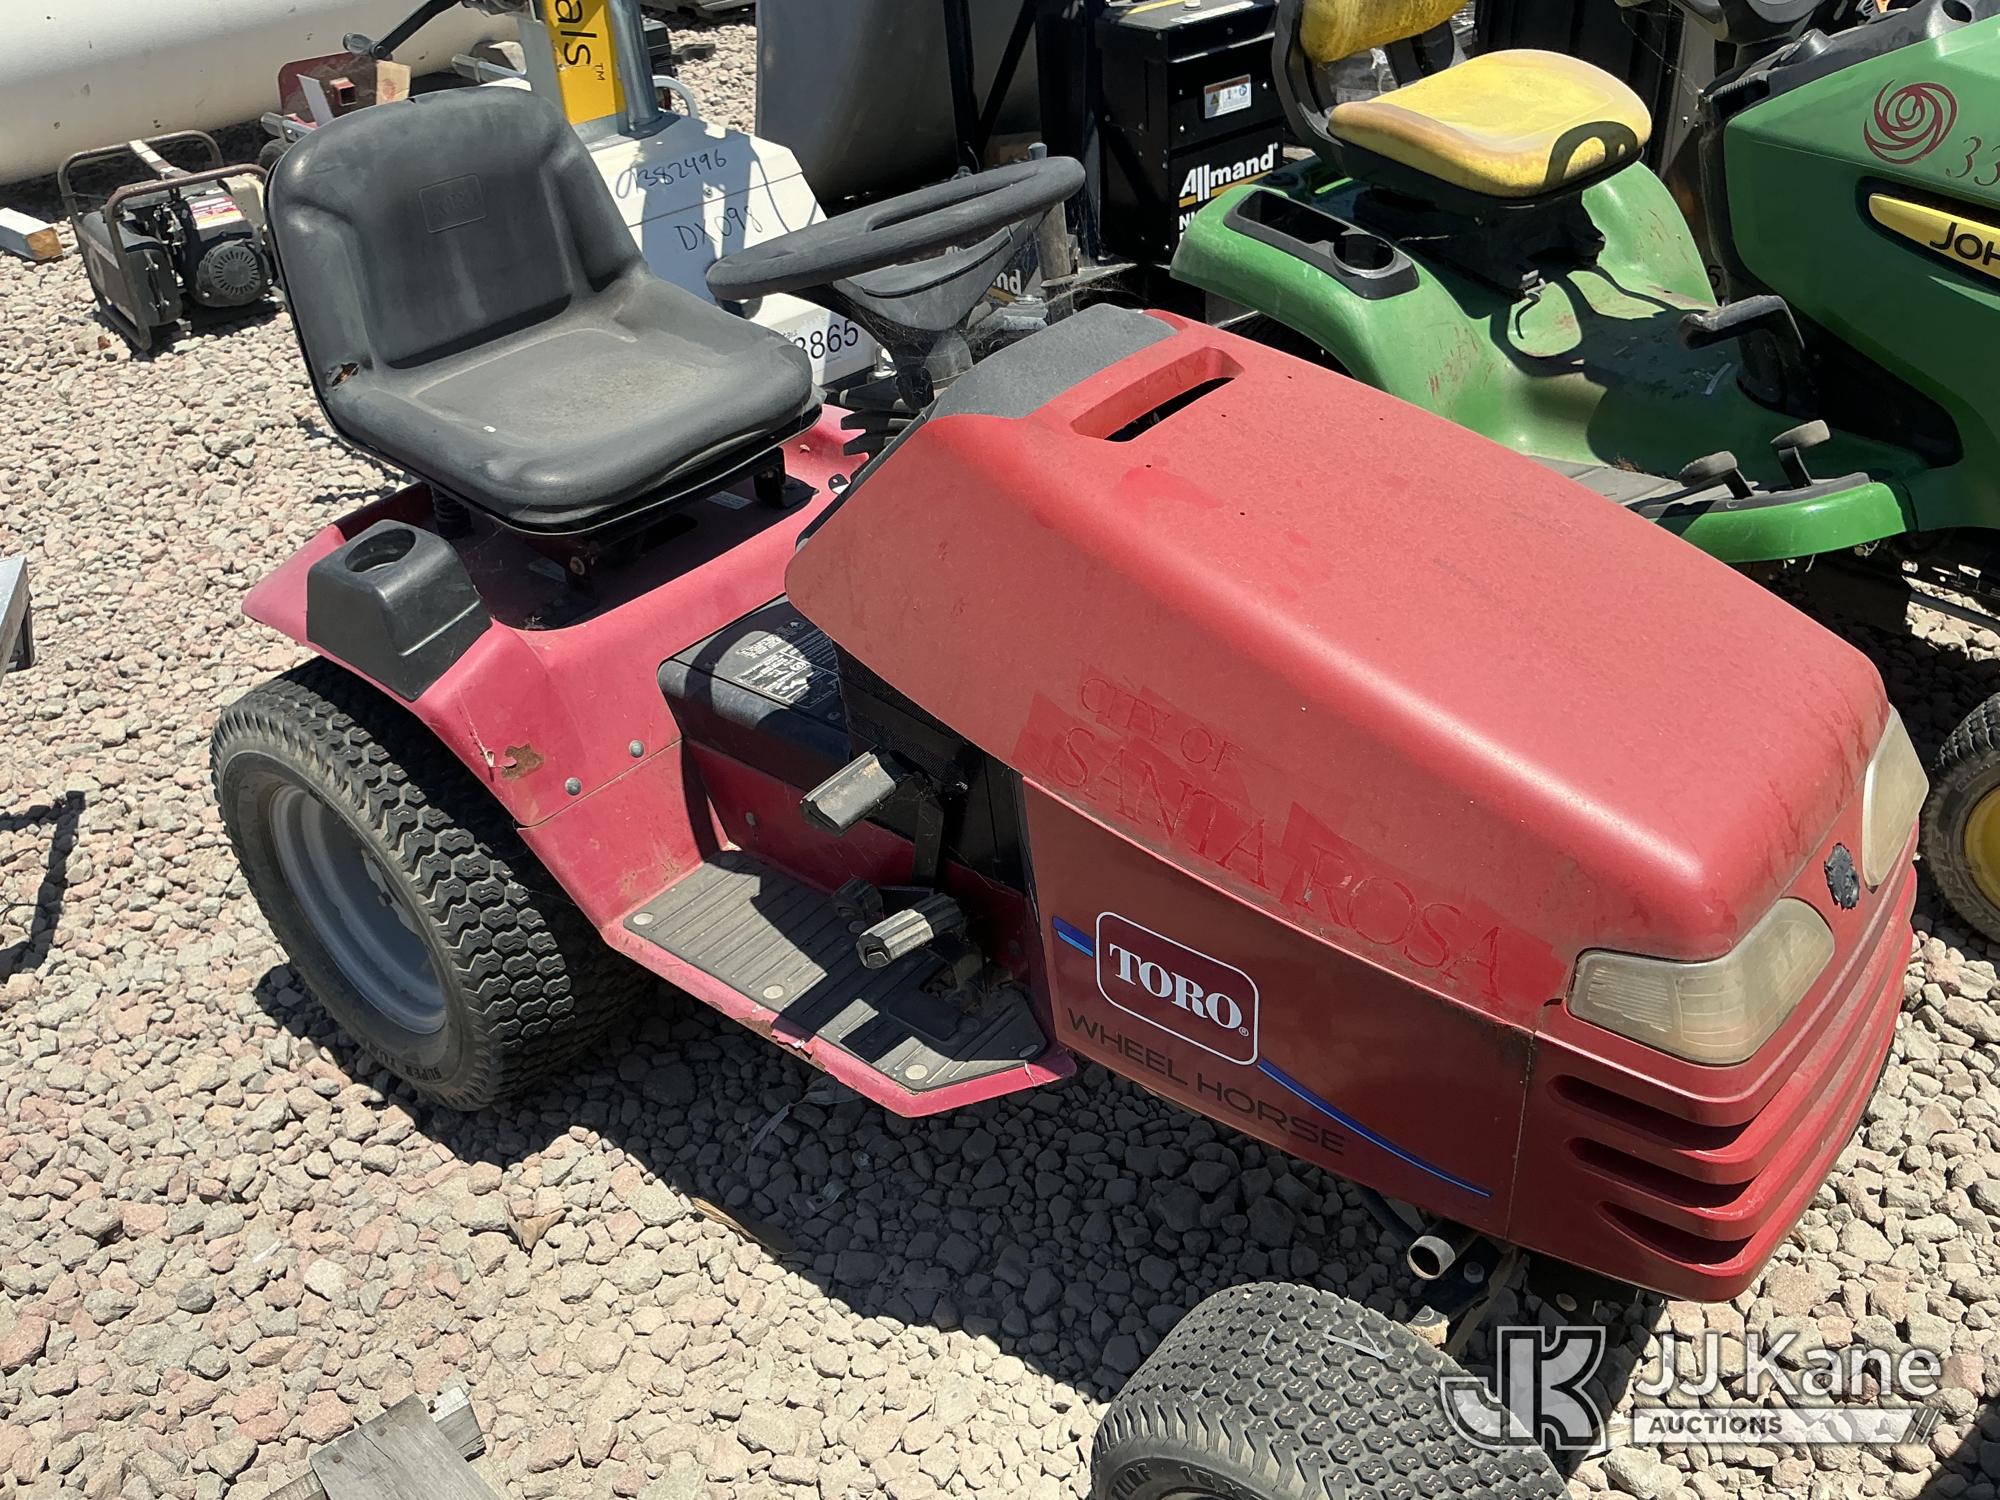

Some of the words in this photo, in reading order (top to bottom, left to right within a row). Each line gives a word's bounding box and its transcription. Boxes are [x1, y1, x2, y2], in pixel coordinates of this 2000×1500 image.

[1081, 678, 1173, 743] CITY
[1180, 726, 1243, 772] OF
[1055, 727, 1270, 891] SANTA
[1297, 843, 1504, 1001] ROSA
[1067, 1007, 1188, 1086] WHEEL
[1197, 1072, 1345, 1156] HORSE
